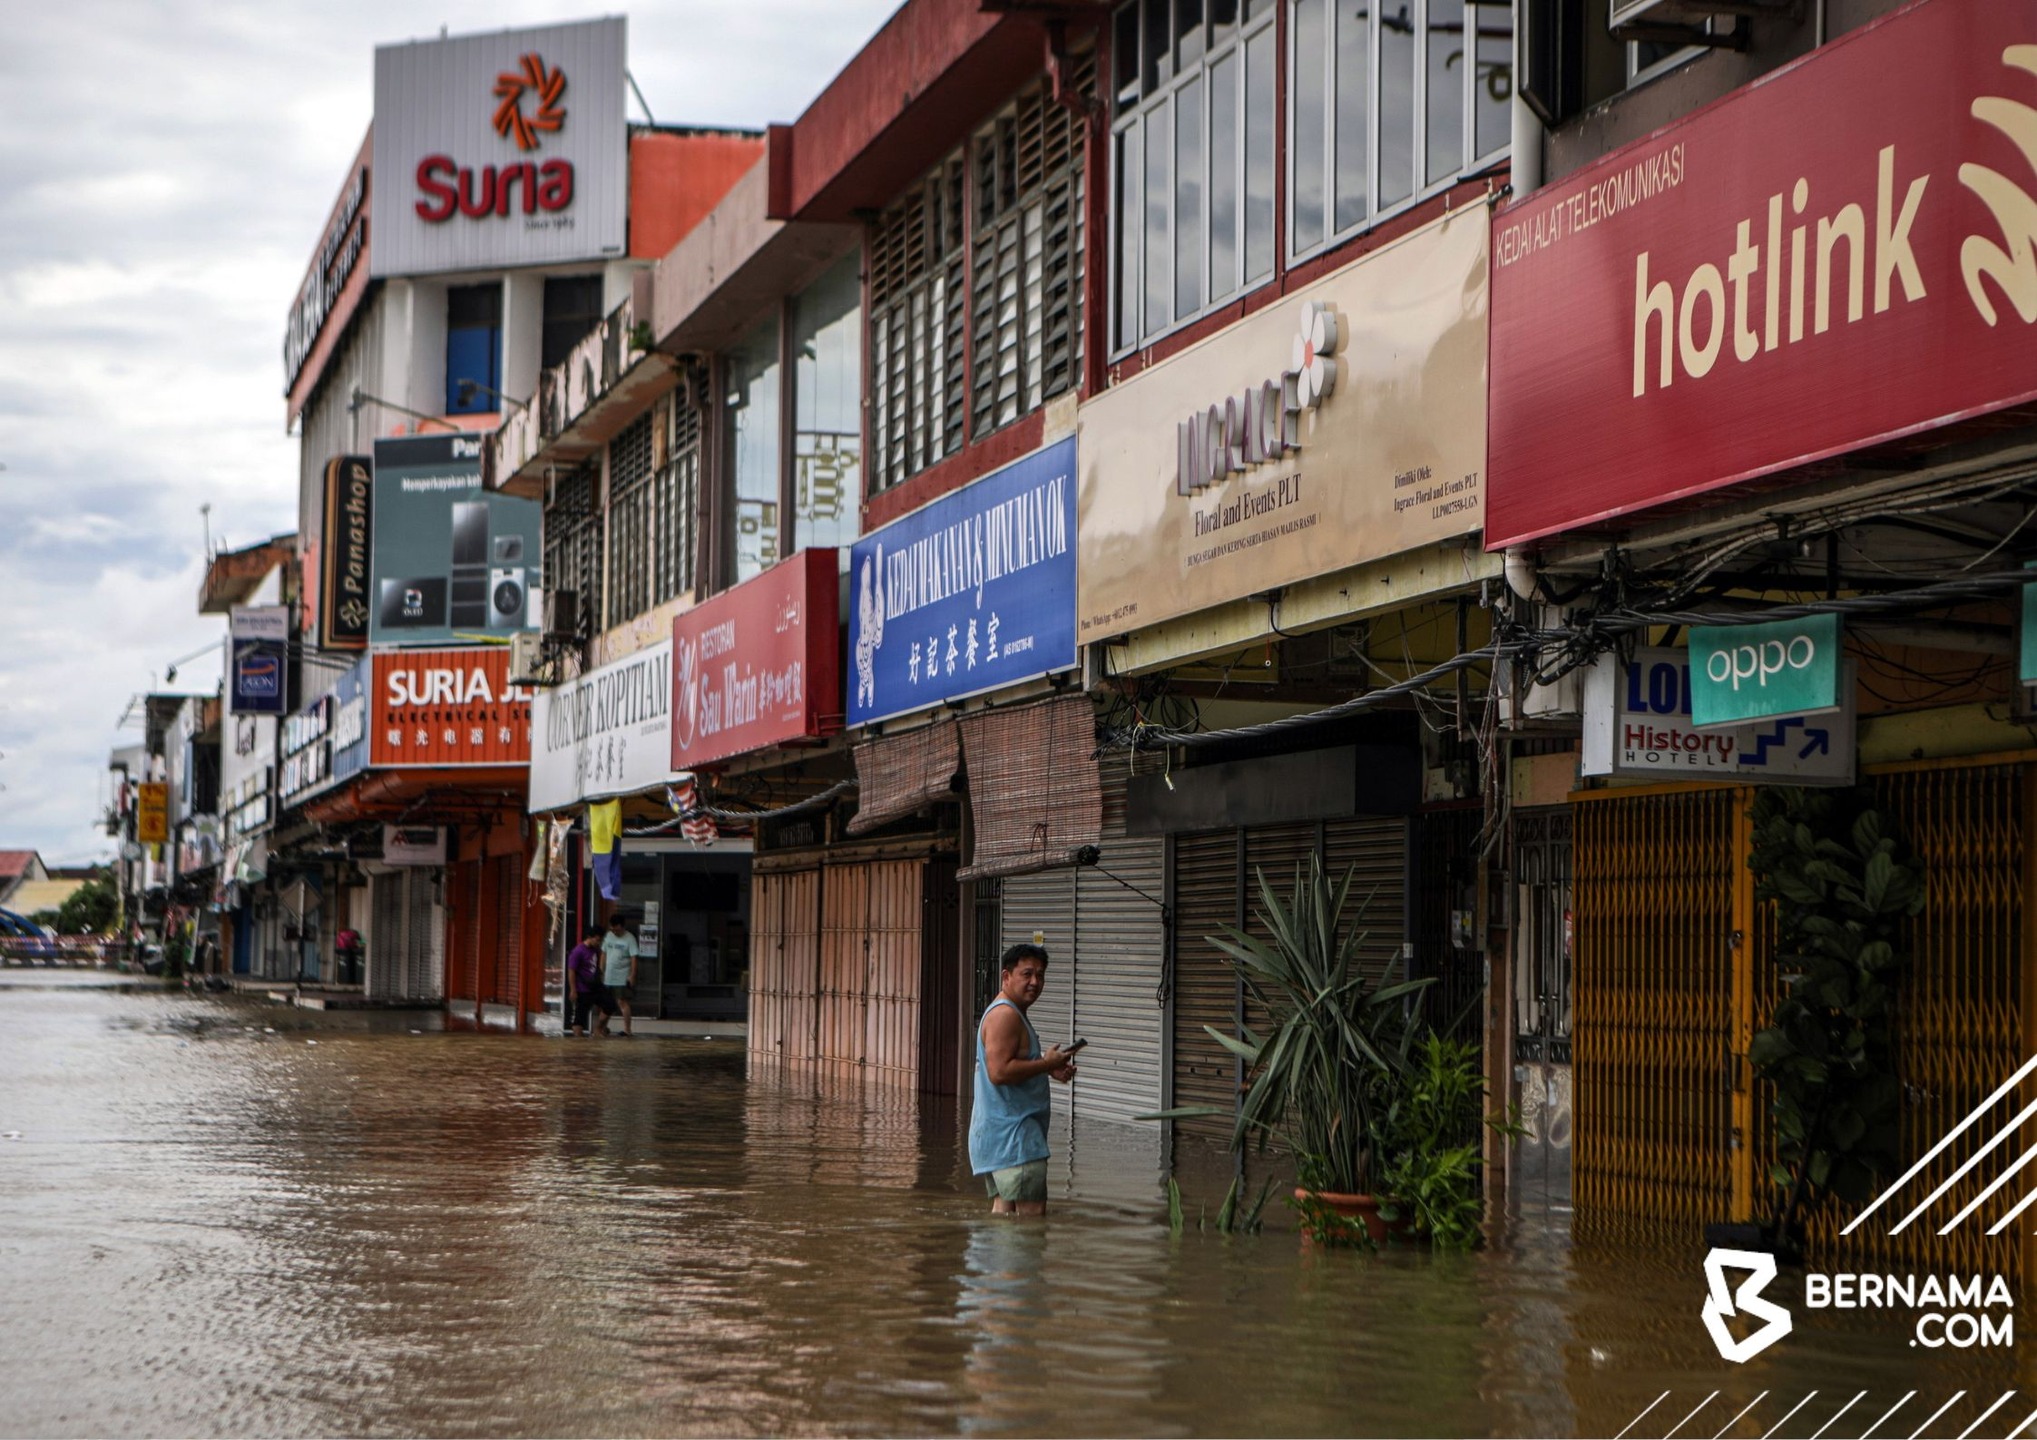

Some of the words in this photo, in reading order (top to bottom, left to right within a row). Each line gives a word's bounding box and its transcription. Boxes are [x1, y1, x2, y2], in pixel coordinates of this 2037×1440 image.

[415, 154, 574, 223] Suria
[1496, 218, 1532, 269] KEDAI
[1533, 203, 1564, 252] ALAT
[1566, 142, 1685, 235] TELEKOMUNIKASI
[1633, 144, 1930, 398] hotlink
[1177, 370, 1302, 497] INGRACE
[1194, 503, 1221, 537] Floral
[1222, 498, 1241, 528] and
[1243, 488, 1276, 520] Events
[1277, 473, 1303, 509] PLT
[1394, 496, 1415, 513] Ingrace
[1415, 487, 1433, 505] Floral
[1433, 483, 1444, 499] and
[1444, 480, 1464, 496] Events
[1464, 472, 1478, 489] PLT
[343, 463, 371, 595] Panashop
[887, 542, 918, 620] KEDAI
[918, 517, 973, 608] MAKANAN
[973, 513, 985, 610] &
[985, 484, 1046, 583] MINUMAN
[1046, 474, 1067, 559] OK
[1261, 526, 1280, 544] HIASAN
[1280, 521, 1299, 537] MAJLIS
[1299, 513, 1317, 530] RASMI
[701, 617, 735, 662] RESTORAN
[1706, 634, 1815, 691] oppo
[388, 667, 494, 706] SURIA
[388, 709, 499, 724] ELECTRICAL
[547, 682, 594, 753] CORNER
[595, 652, 670, 734] KOPITIAM
[700, 673, 722, 737] Sau
[723, 661, 757, 729] Warin
[1624, 724, 1734, 763] History
[1626, 751, 1715, 765] HOTEL
